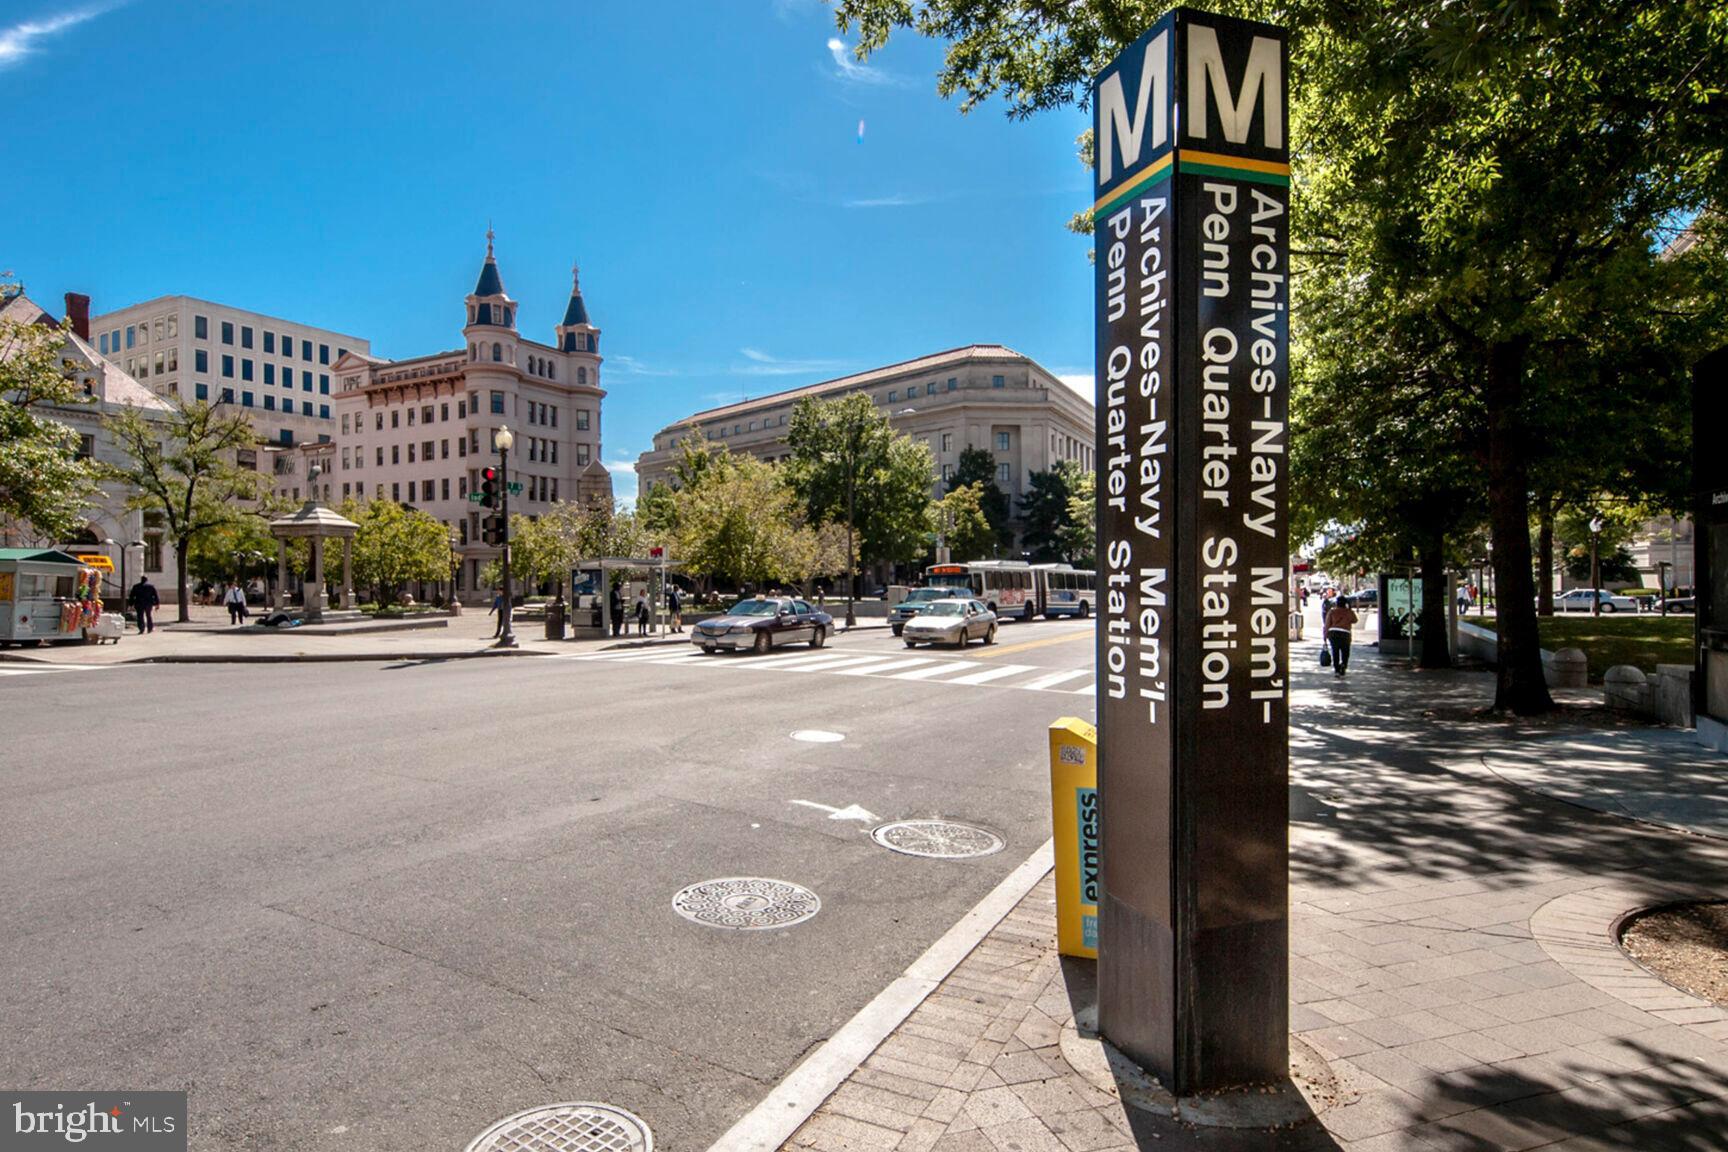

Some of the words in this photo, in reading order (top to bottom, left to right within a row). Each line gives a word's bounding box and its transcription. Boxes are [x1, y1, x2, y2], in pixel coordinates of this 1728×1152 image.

[1099, 29, 1168, 186] M
[1187, 23, 1282, 149] M
[1108, 206, 1131, 323] Penn
[1203, 182, 1237, 298] Penn
[1107, 345, 1131, 512] Quarter
[1202, 327, 1238, 507] Quarter
[1107, 540, 1132, 699] Station
[1202, 537, 1238, 709] Station
